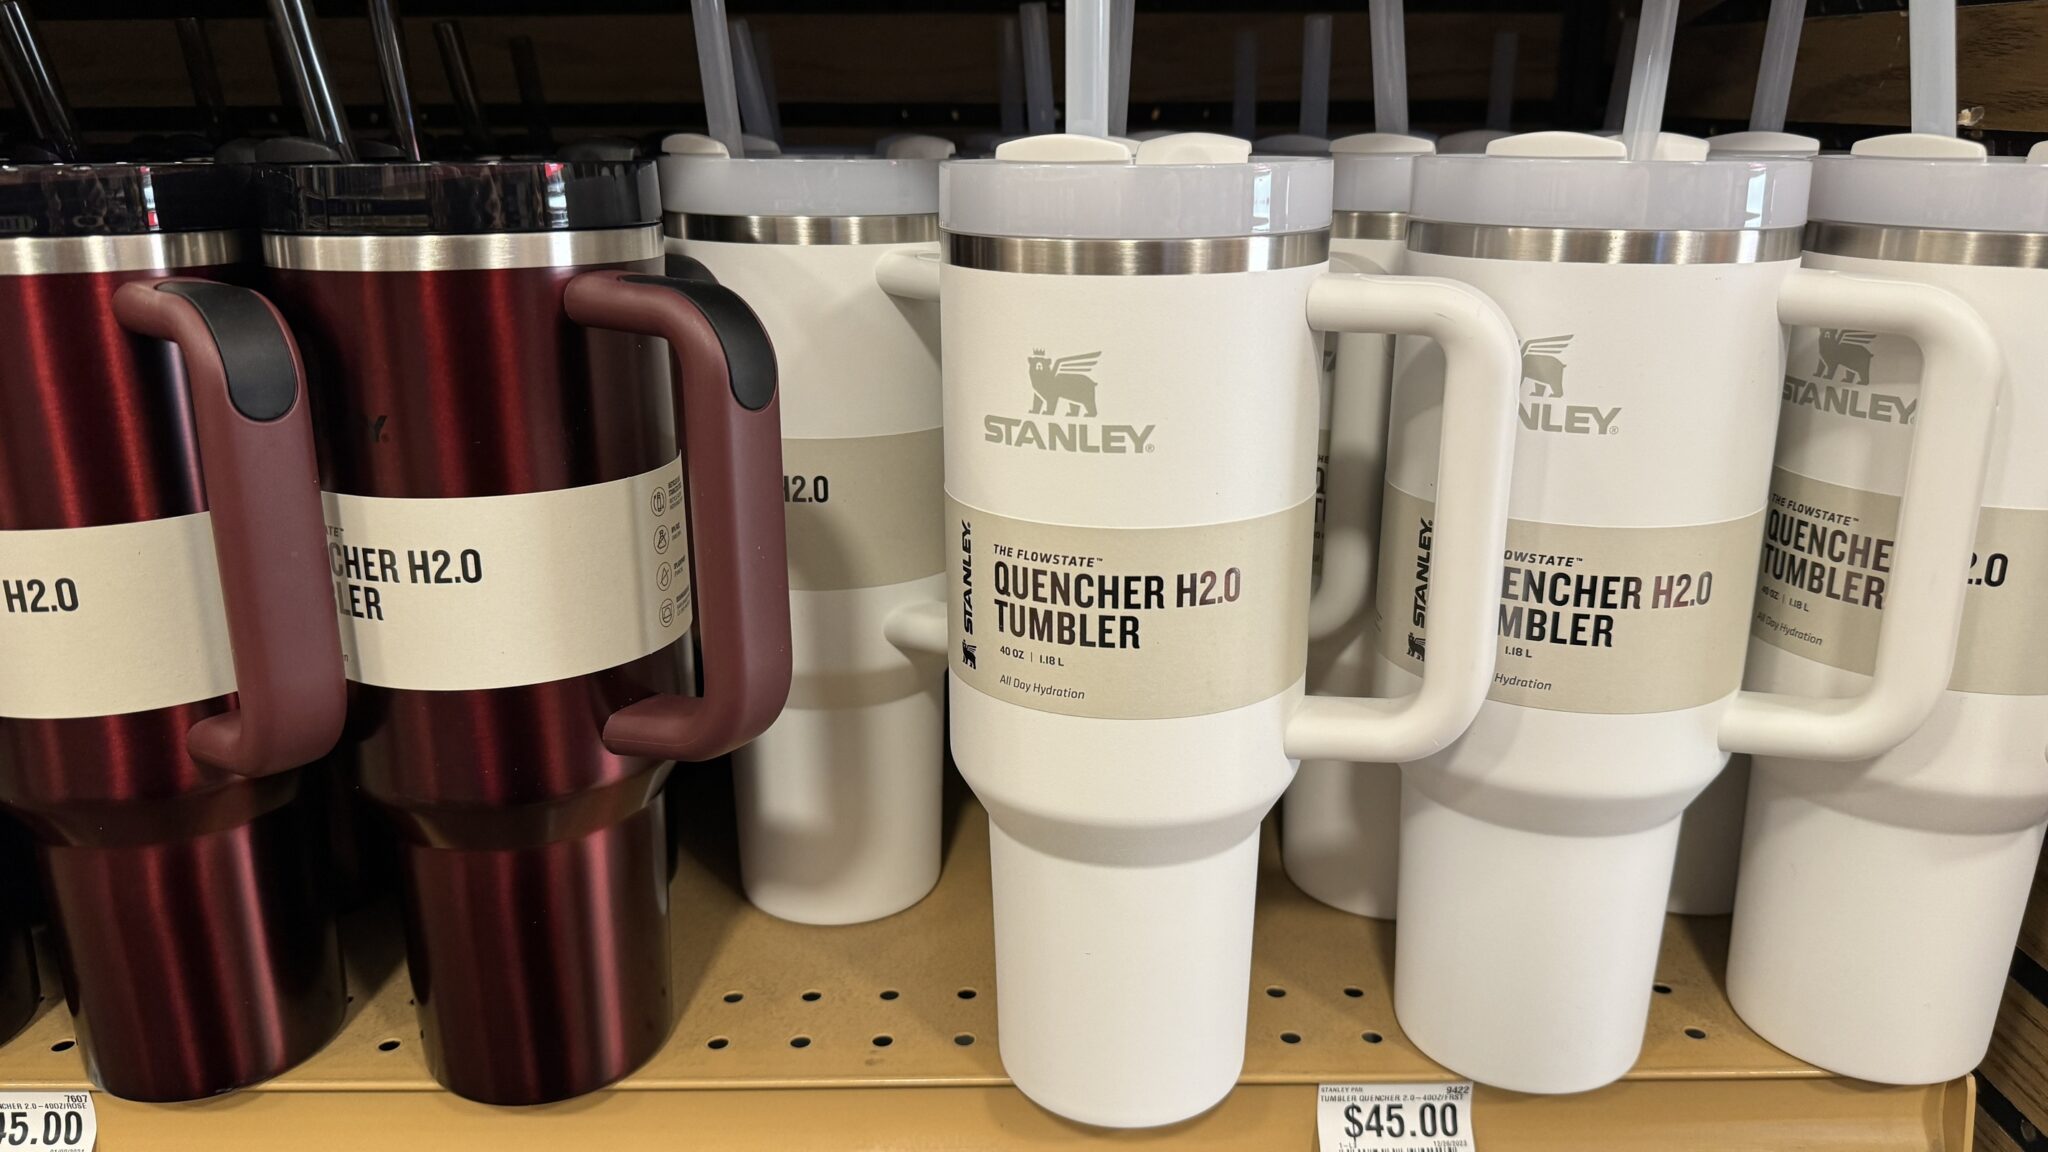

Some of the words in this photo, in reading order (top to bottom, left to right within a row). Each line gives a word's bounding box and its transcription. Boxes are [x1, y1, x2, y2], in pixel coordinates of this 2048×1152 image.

[1772, 493, 1785, 507] THE
[993, 543, 1014, 558] THE
[1767, 509, 1894, 573] QUENCHE
[328, 541, 400, 584] CHER
[407, 548, 483, 584] H2.0
[994, 561, 1165, 610] QUENCHER
[1176, 567, 1241, 608] H2.0
[1502, 566, 1642, 610] ENCHER
[1652, 571, 1713, 609] H2.0
[1764, 543, 1885, 610] TUMBLER
[2, 577, 79, 613] H2.0
[994, 598, 1140, 649] TUMBLER
[1498, 604, 1614, 648] MBLER
[1779, 621, 1823, 646] Hydration
[1000, 646, 1011, 657] 40
[1012, 649, 1024, 660] OZ
[1040, 655, 1055, 666] 1.18
[1058, 657, 1064, 667] L
[1505, 645, 1522, 657] 1.18
[1525, 648, 1532, 658] L
[1000, 674, 1012, 686] All
[1013, 677, 1031, 693] Day
[1033, 683, 1085, 700] Hydration
[1494, 673, 1552, 691] Hydration
[64, 1094, 88, 1103] 7607
[1320, 1094, 1356, 1102] TUMBLER
[1446, 1086, 1470, 1094] 9422
[1344, 1102, 1458, 1143] $45.00
